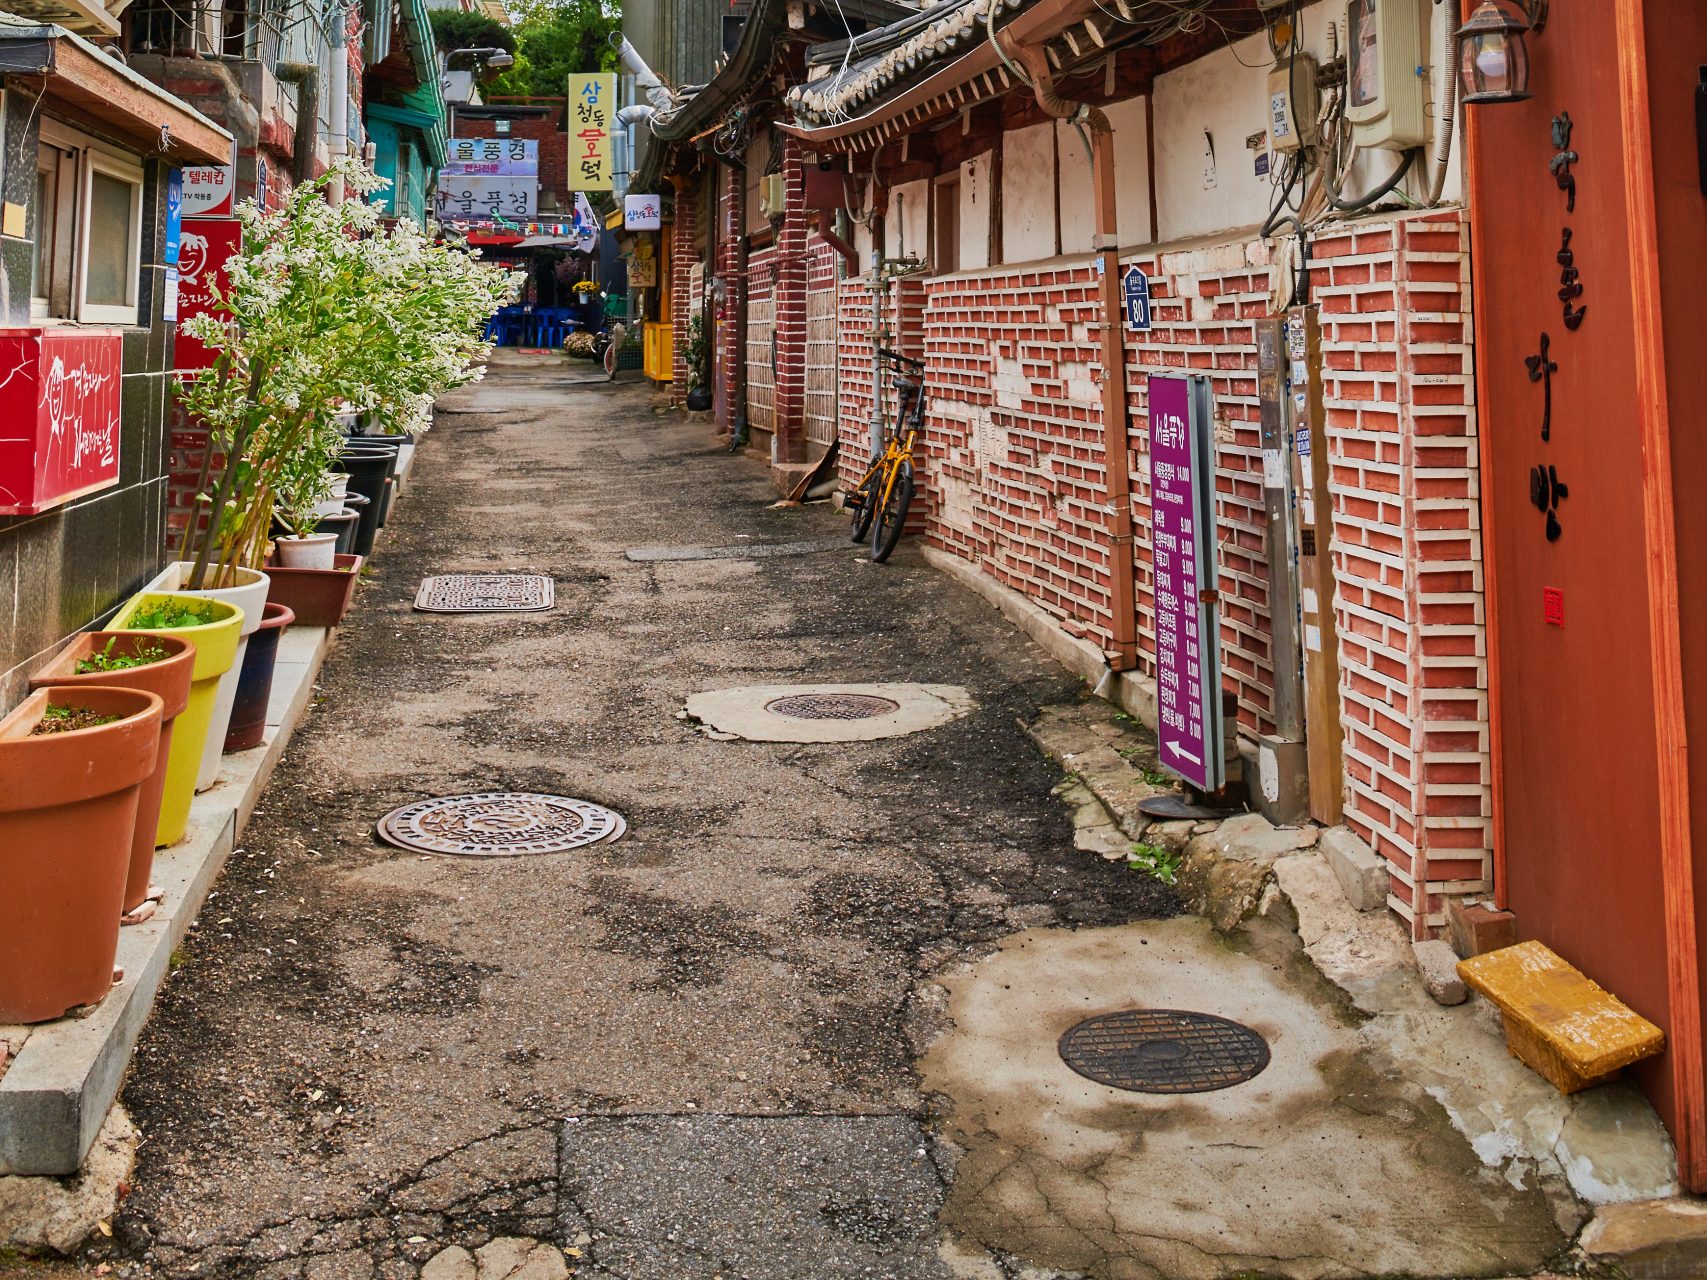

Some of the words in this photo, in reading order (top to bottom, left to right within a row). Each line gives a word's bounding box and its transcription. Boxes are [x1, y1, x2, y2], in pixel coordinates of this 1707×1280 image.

[189, 171, 225, 185] 텔레캅
[1133, 299, 1143, 323] 80
[1155, 413, 1184, 450] 서울풍경
